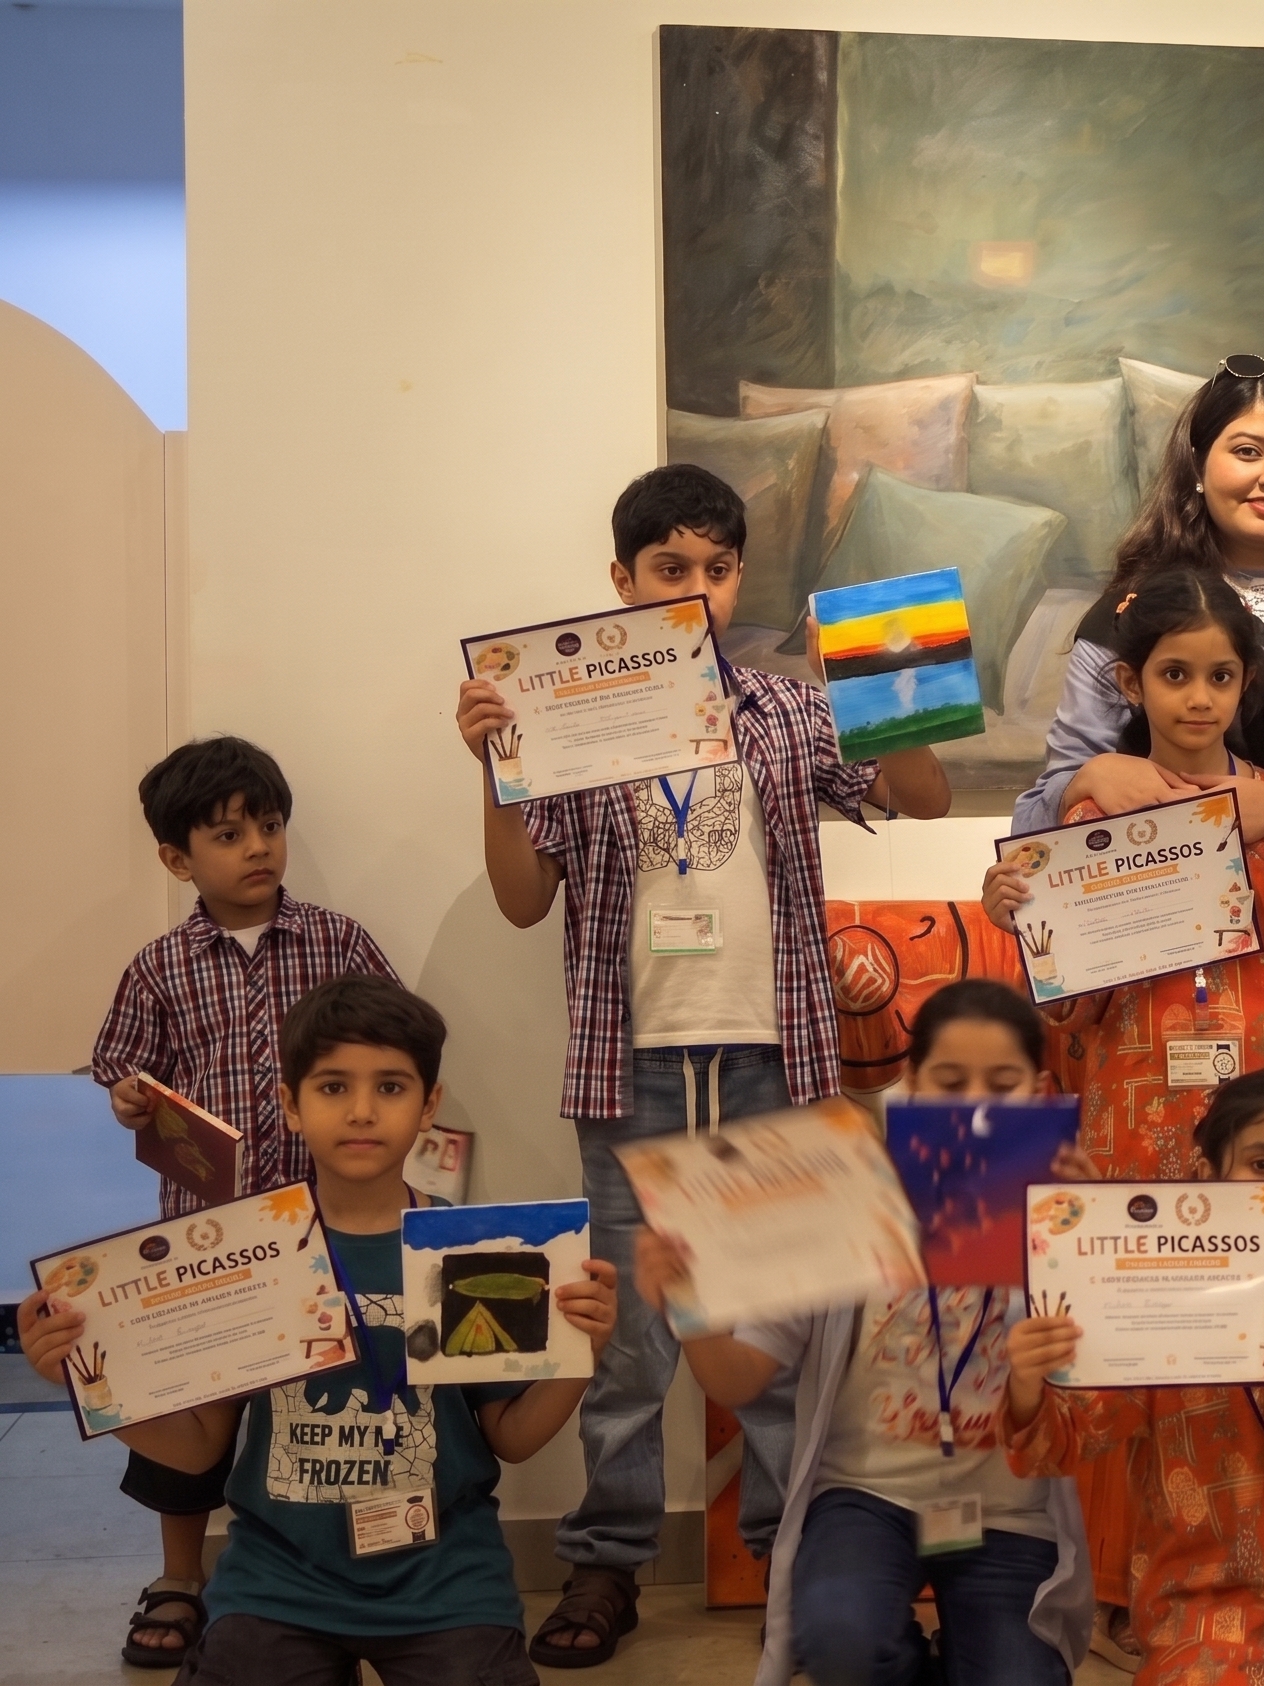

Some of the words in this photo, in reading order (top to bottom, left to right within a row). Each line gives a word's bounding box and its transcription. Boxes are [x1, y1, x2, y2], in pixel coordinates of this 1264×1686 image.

[518, 666, 583, 693] LITTLE
[586, 648, 678, 679] PICASSOS
[1048, 861, 1110, 889] LITTLE
[1114, 841, 1204, 873] PICASSOS
[1077, 1235, 1149, 1256] LITTLE
[1157, 1235, 1261, 1253] PICASSOS
[98, 1270, 171, 1308] LITTLE
[175, 1241, 281, 1283] PICASSOS
[290, 1422, 333, 1446] KEEP
[338, 1425, 369, 1448] MY
[298, 1457, 391, 1486] FROZEN
